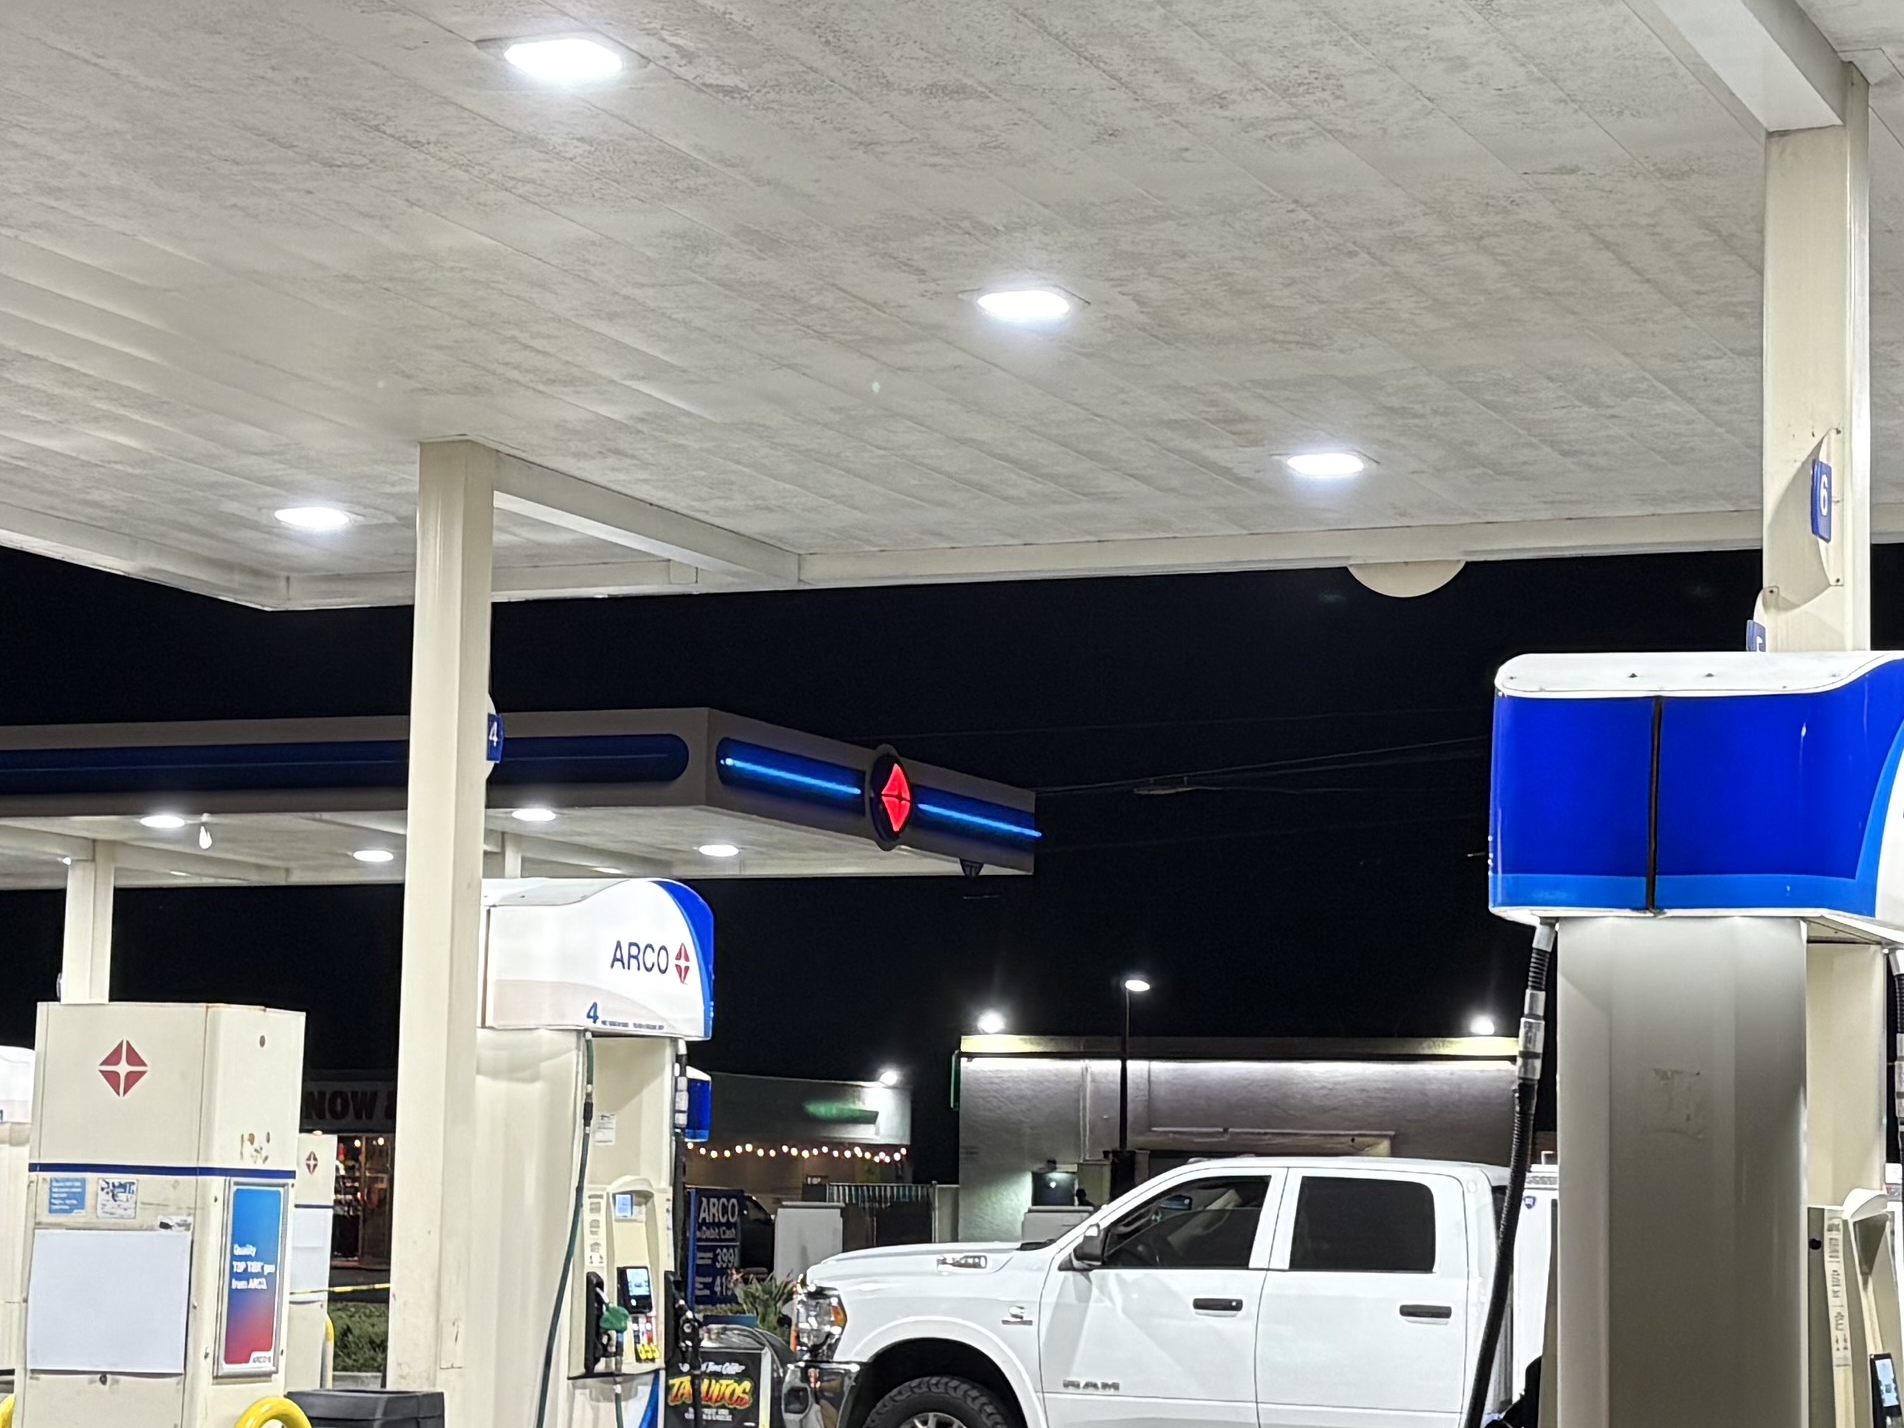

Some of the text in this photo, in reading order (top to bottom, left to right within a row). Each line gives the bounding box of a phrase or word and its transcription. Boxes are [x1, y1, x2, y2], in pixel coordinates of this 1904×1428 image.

[1820, 474, 1829, 517] 6
[610, 940, 669, 974] ARCO
[586, 1002, 599, 1024] 4
[699, 1197, 739, 1224] ARCO
[668, 1376, 753, 1408] TAUITOS
[1063, 1379, 1120, 1391] RAM
